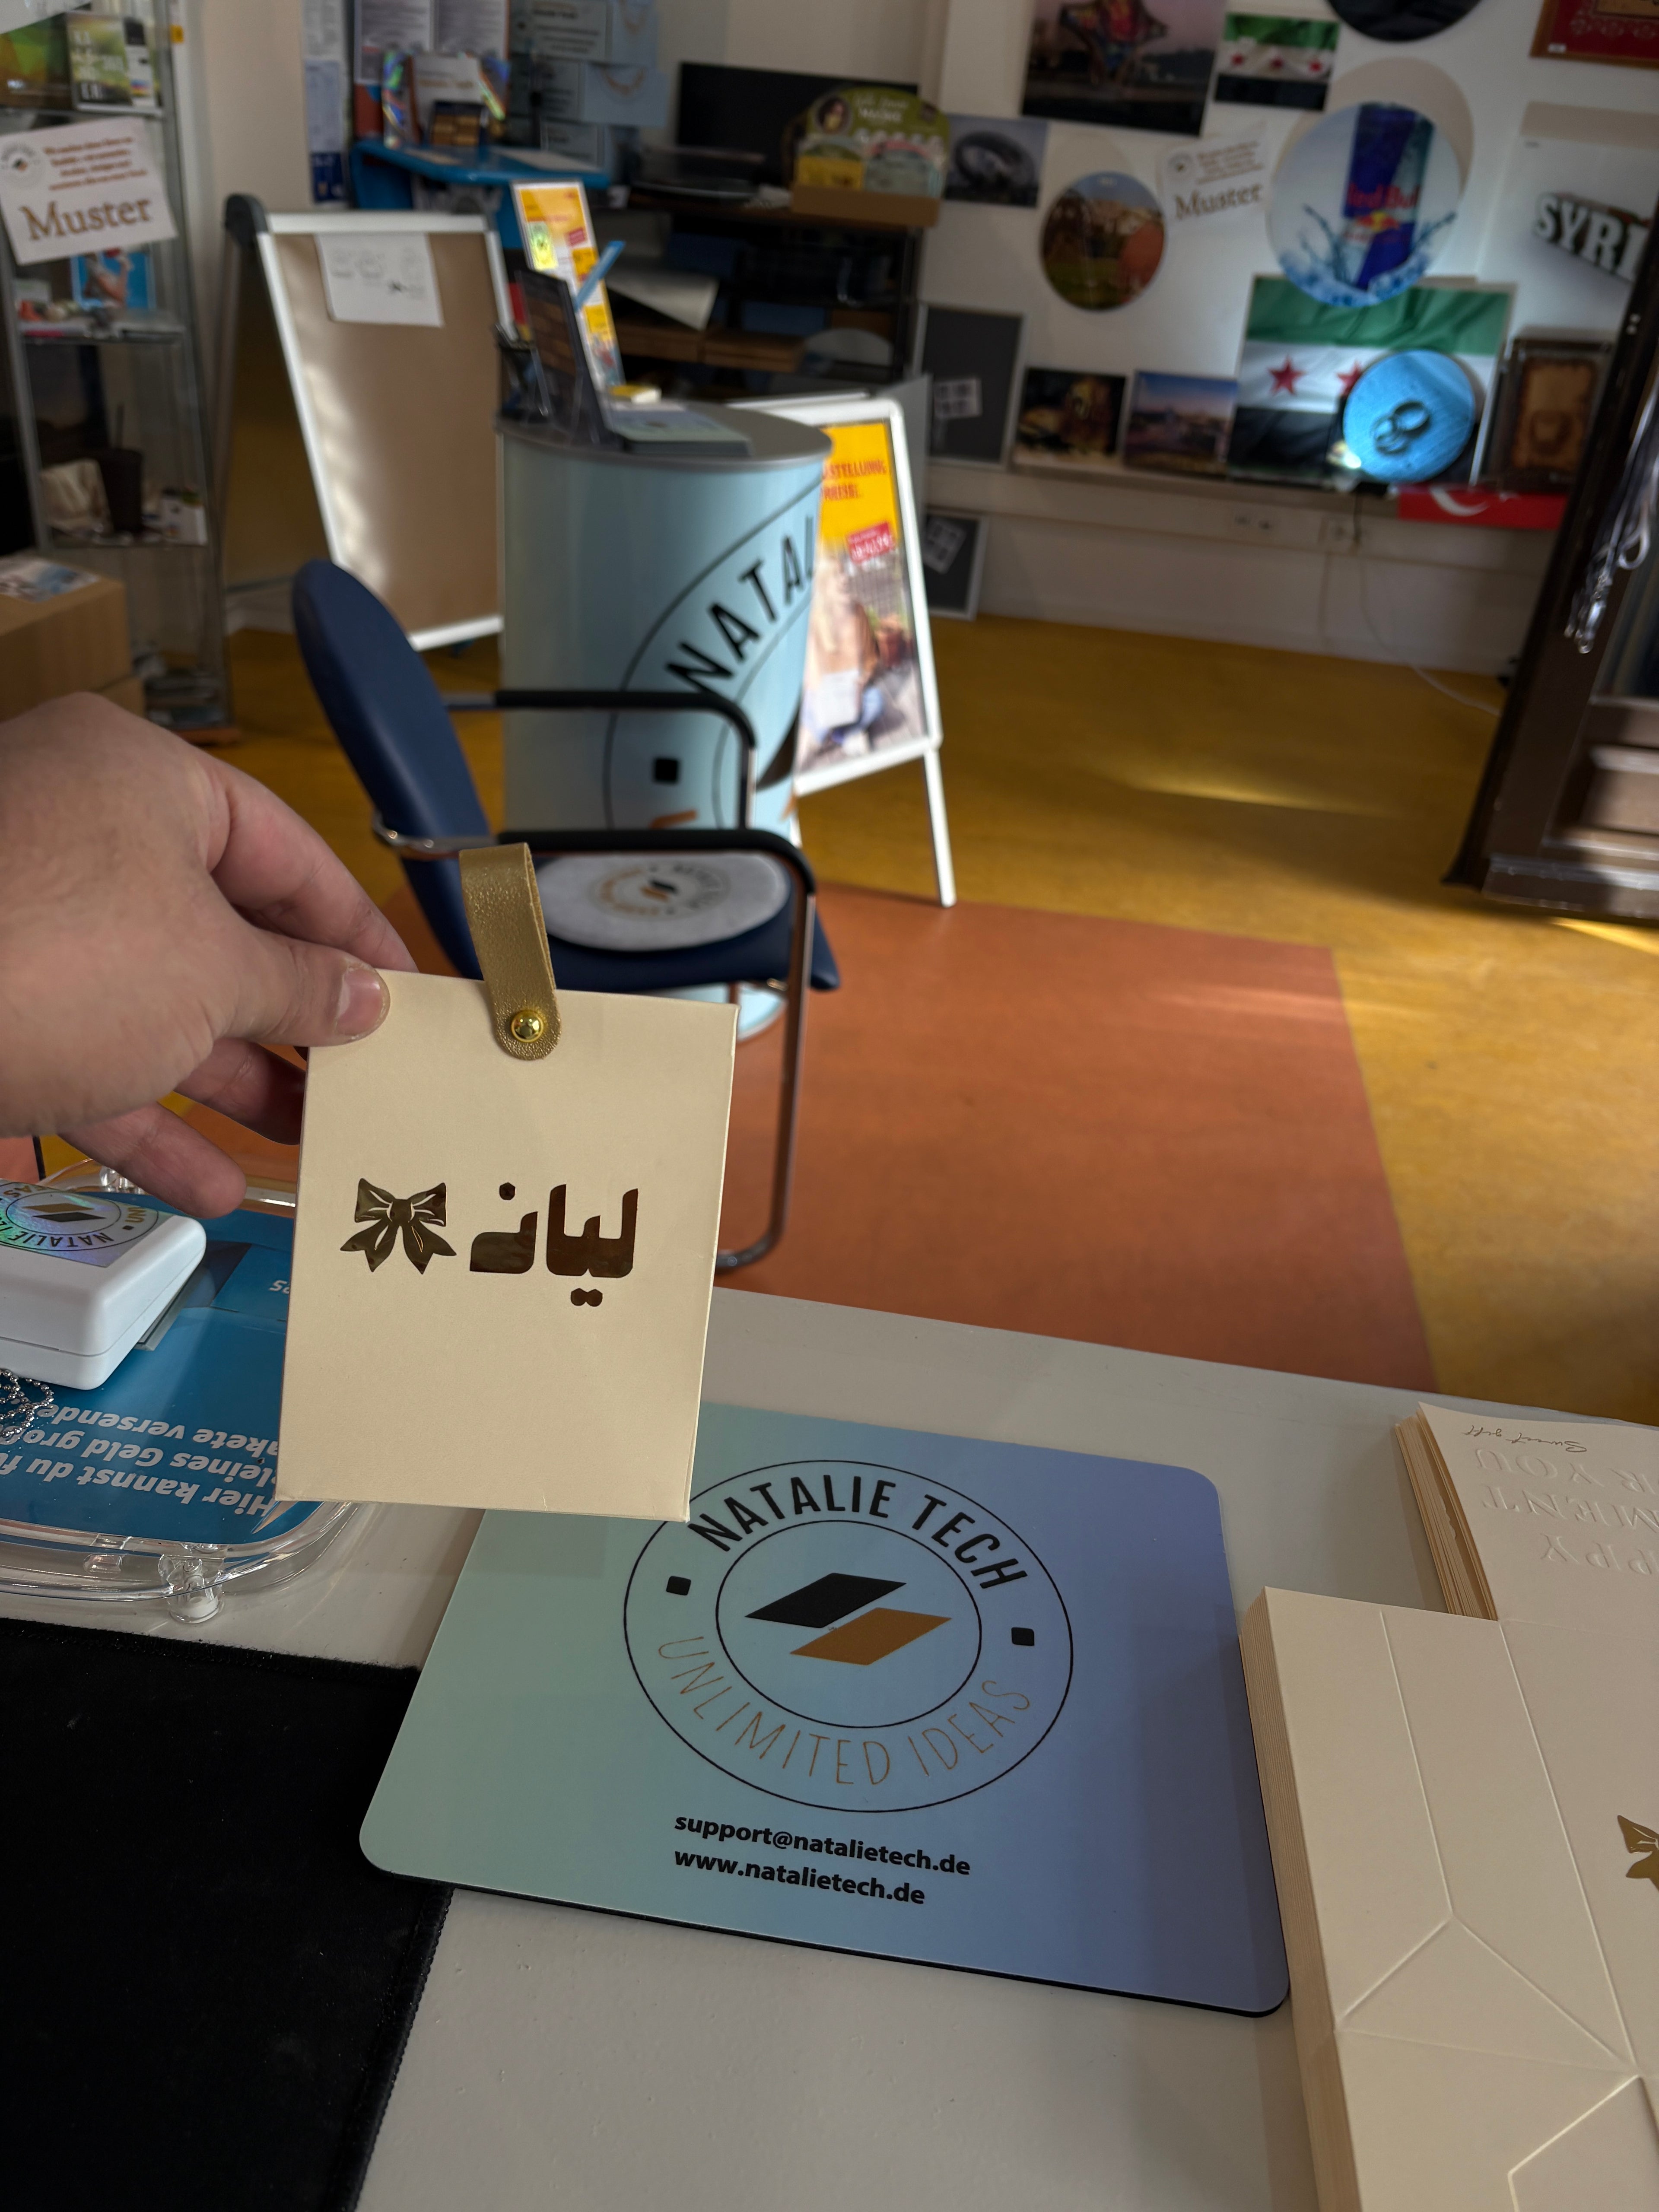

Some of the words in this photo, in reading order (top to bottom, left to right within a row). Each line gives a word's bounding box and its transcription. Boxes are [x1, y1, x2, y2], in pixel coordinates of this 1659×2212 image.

[20, 200, 150, 240] Muster
[8, 1231, 114, 1248] NATALIE
[26, 1458, 74, 1482] du
[81, 1438, 164, 1467] Geld
[170, 1452, 276, 1487] leines
[76, 1465, 200, 1504] kannst
[202, 1487, 275, 1517] Hier
[687, 1474, 896, 1552] NATALIE
[912, 1494, 1028, 1589] TECH
[658, 1636, 890, 1785] UNLIMITED
[908, 1680, 1030, 1777] IDEAS
[674, 1816, 971, 1875] support@natalietech.de
[674, 1850, 925, 1904] www.natalietech.de
